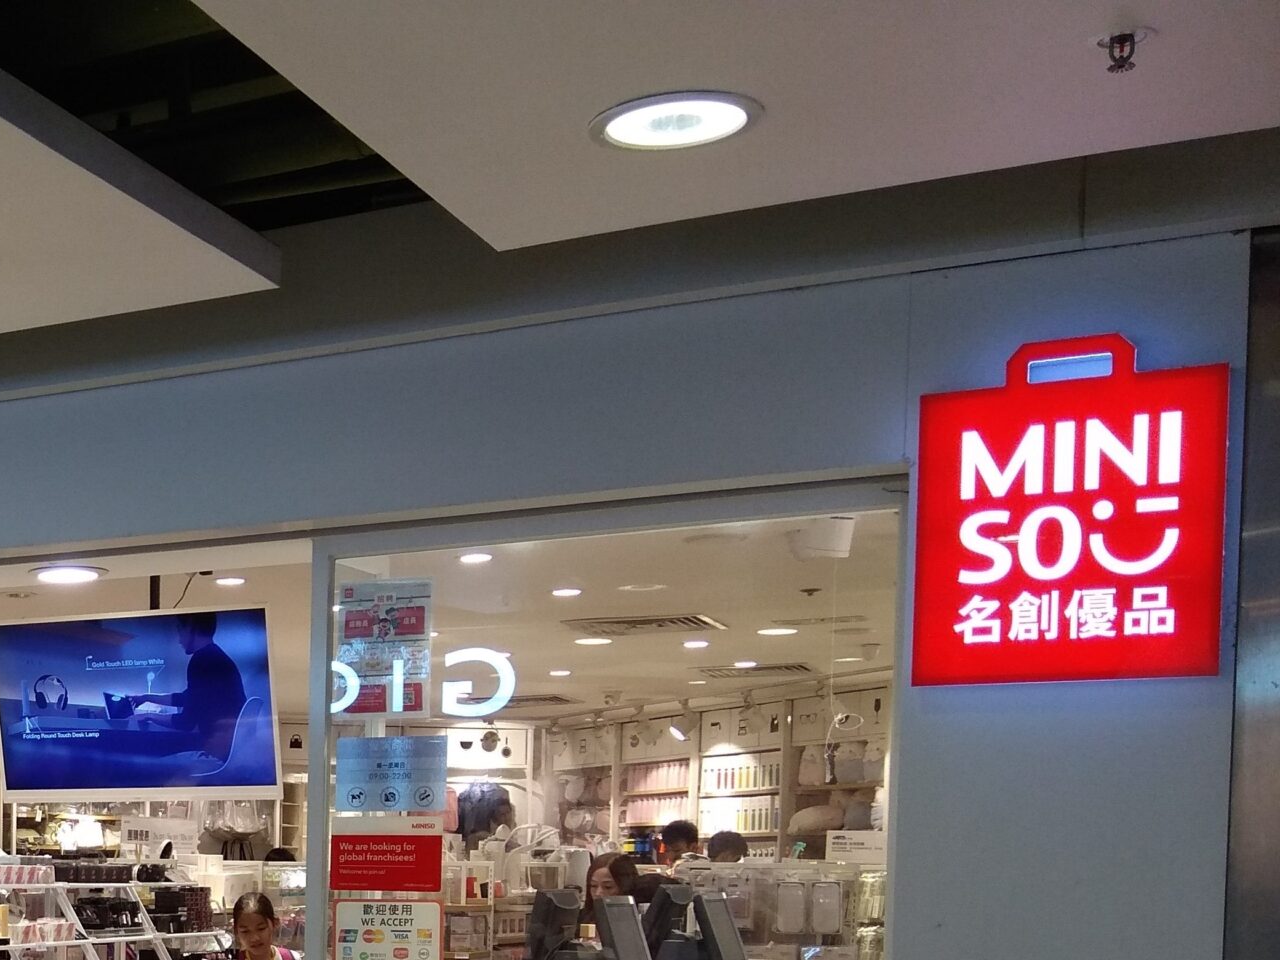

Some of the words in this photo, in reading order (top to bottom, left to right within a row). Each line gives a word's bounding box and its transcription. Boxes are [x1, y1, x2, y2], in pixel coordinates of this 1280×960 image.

[959, 410, 1183, 501] MINI
[952, 585, 1176, 645] 名創優品
[411, 822, 436, 830] MINISO
[339, 842, 355, 851] We
[355, 843, 369, 851] are
[370, 842, 402, 853] looking
[403, 842, 416, 851] for
[339, 852, 366, 863] global
[366, 852, 416, 862] franchisees!
[363, 904, 413, 916] 歡迎使用
[360, 917, 376, 927] WE
[379, 917, 415, 927] ACCEPT
